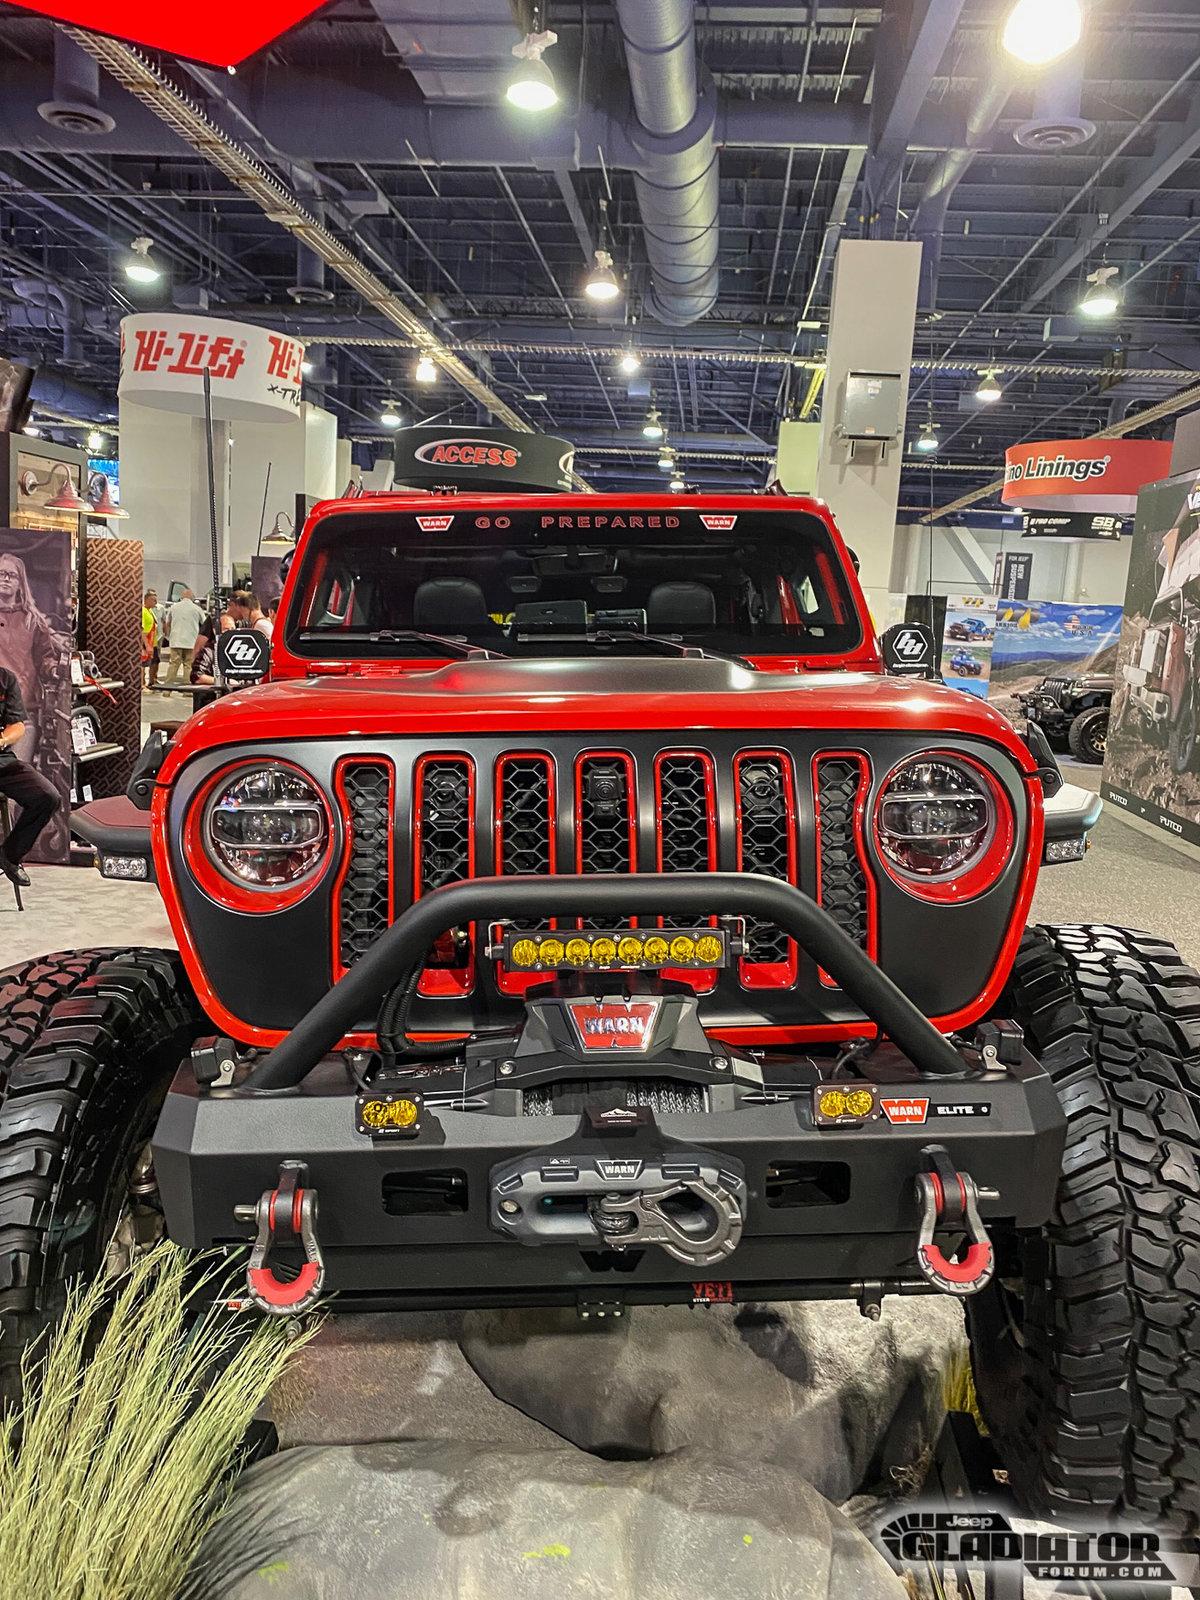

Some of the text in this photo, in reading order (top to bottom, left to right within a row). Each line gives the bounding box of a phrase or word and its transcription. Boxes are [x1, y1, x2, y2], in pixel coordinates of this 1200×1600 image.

[133, 330, 245, 379] Hi-Lift
[432, 445, 517, 467] ACCESS
[1024, 454, 1107, 482] Linings
[475, 516, 680, 529] GO PREPARED
[1160, 815, 1182, 833] PUTCO
[585, 1016, 645, 1034] WARN
[888, 1105, 974, 1116] WARN ELITE
[605, 1165, 635, 1174] WARN
